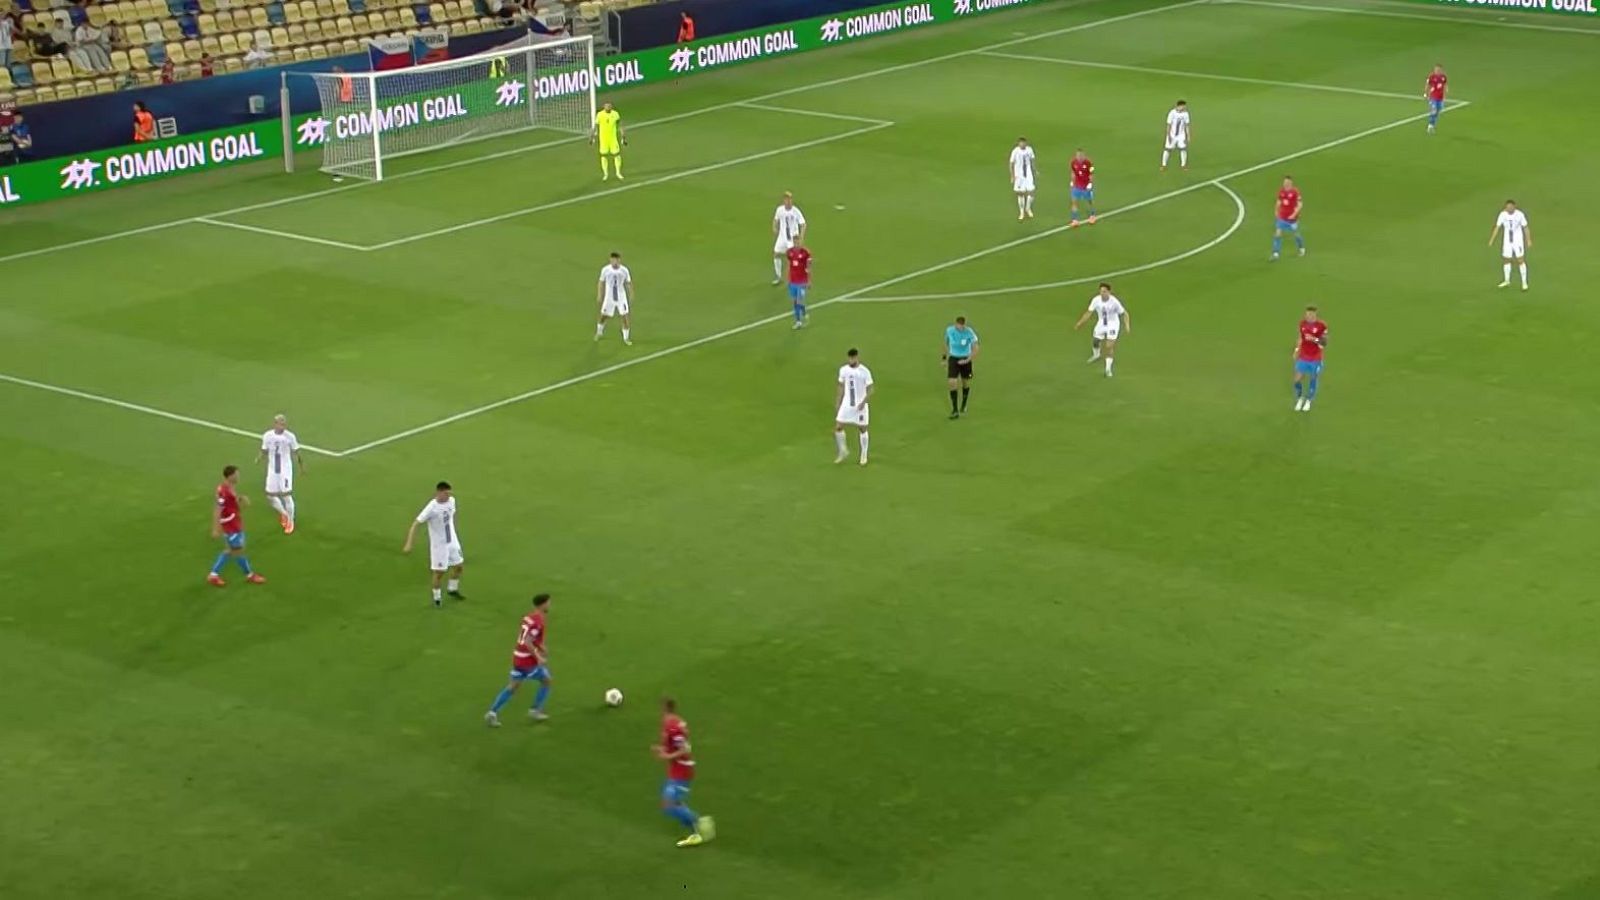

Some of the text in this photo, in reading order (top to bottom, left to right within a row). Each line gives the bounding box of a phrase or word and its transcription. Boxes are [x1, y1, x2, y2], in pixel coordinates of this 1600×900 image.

[845, 3, 934, 38] COMMON GOAL
[697, 30, 799, 67] COMMON GOAL
[605, 59, 644, 86] GOAL
[335, 93, 468, 139] COMMON GOAL
[106, 132, 263, 183] COMMON GOAL
